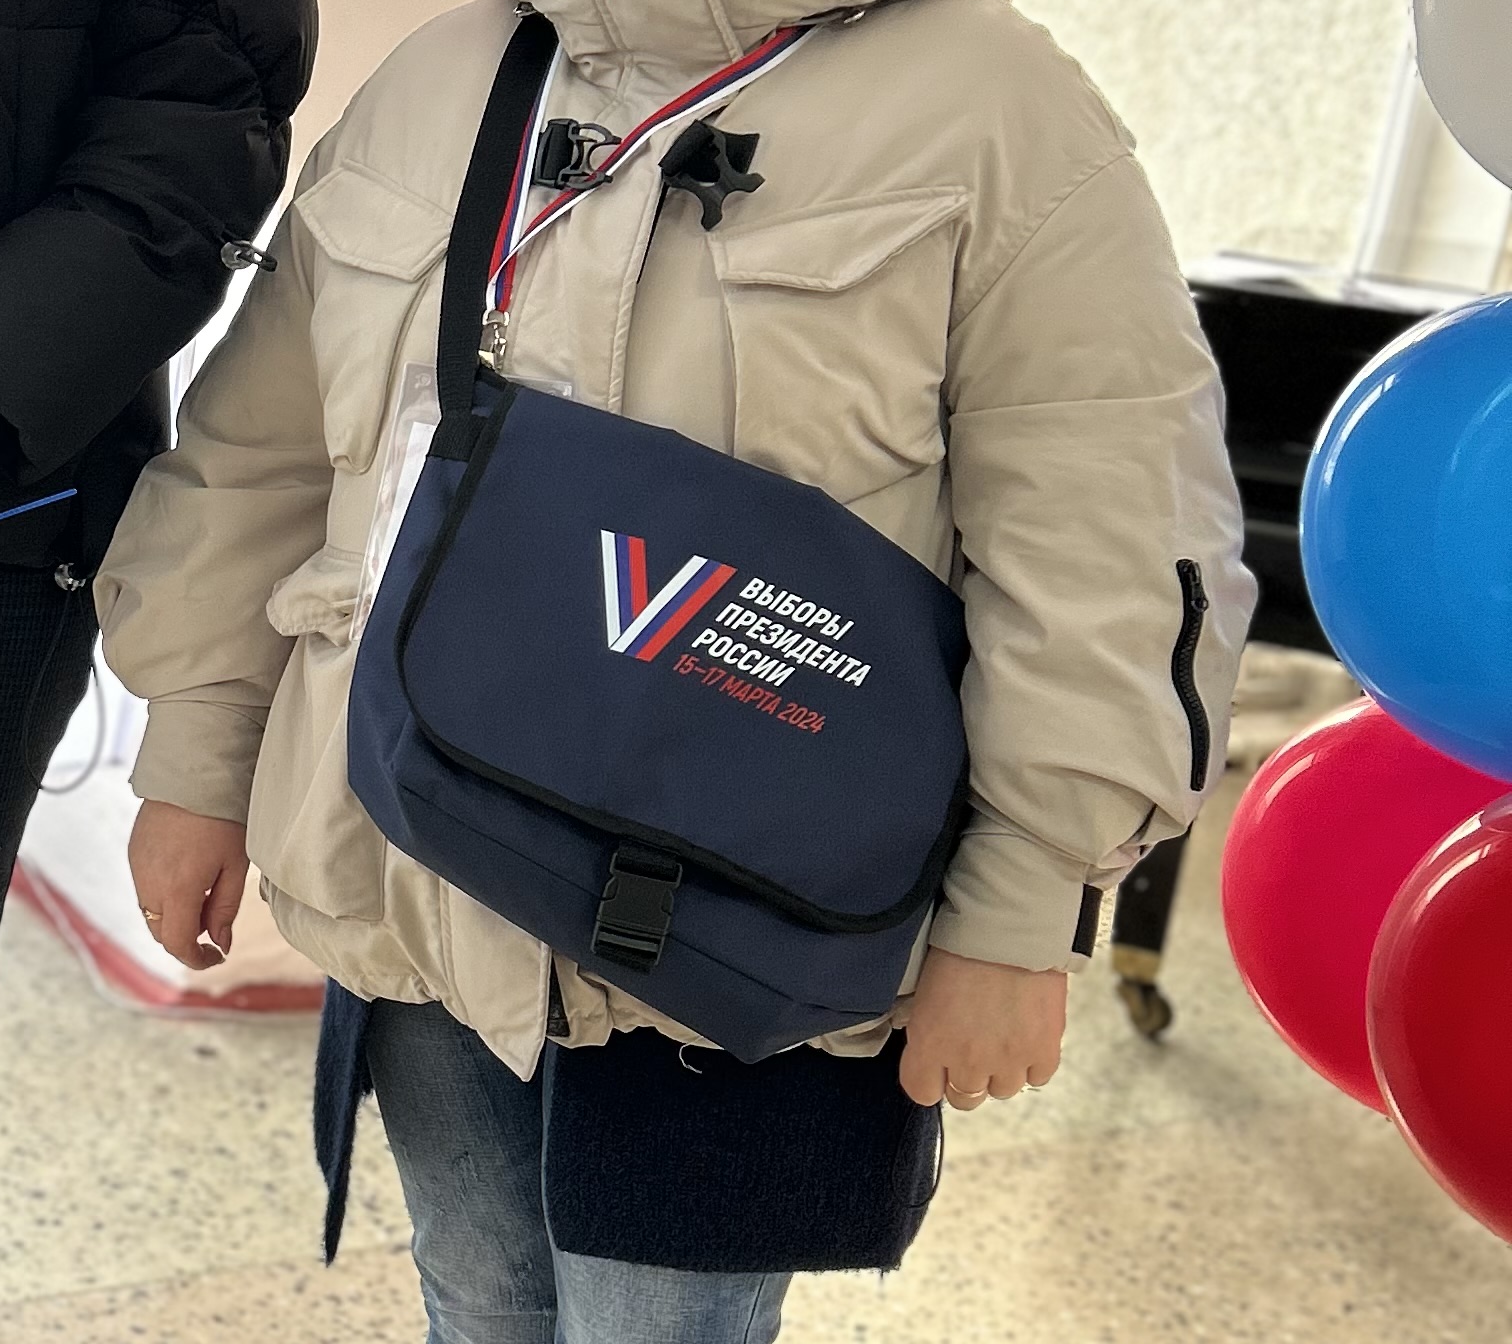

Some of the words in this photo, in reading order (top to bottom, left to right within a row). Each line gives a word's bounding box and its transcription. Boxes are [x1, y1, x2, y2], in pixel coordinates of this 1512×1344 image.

[739, 577, 855, 641] ВЫБОРЫ
[692, 628, 796, 687] РОССИИ
[715, 602, 873, 687] ПРЕЗИДЕНТА
[720, 675, 782, 714] МАРТА
[777, 703, 825, 734] 2024
